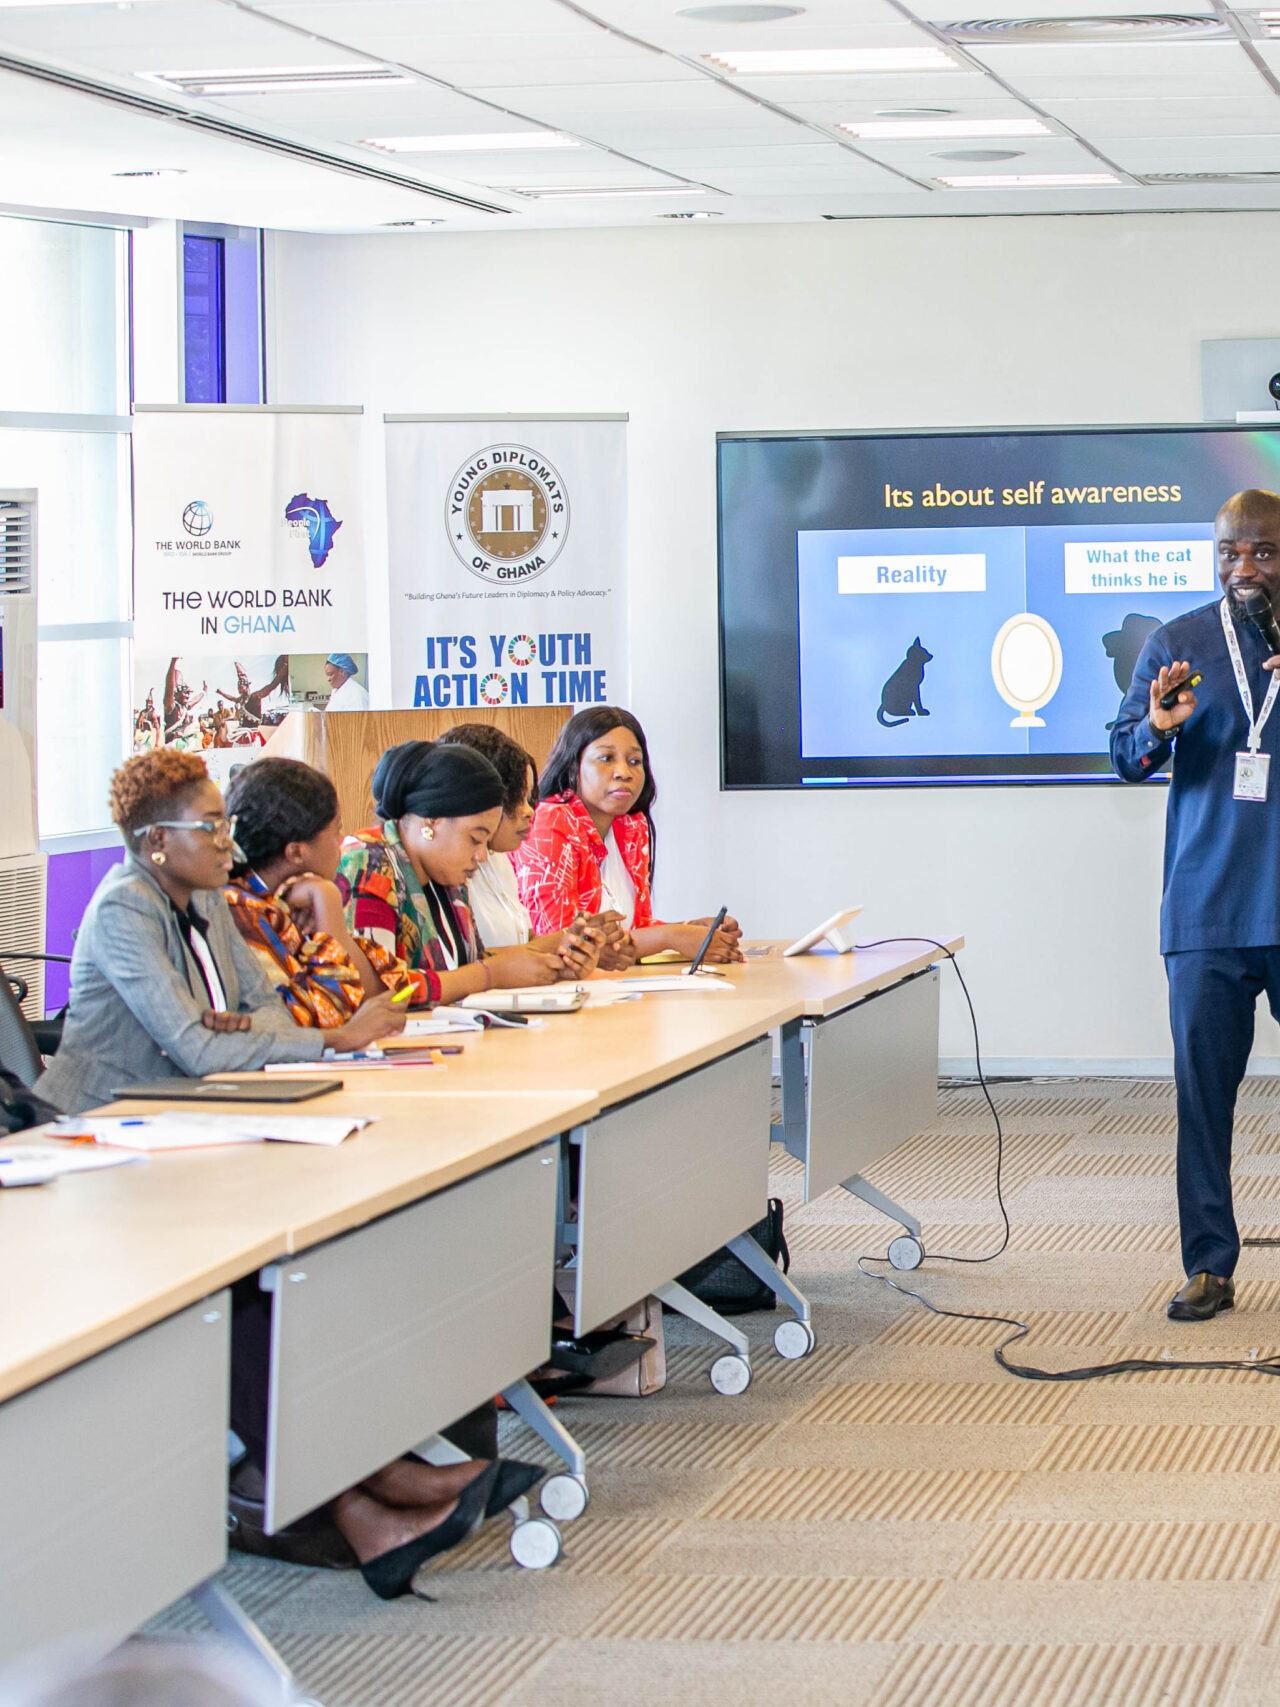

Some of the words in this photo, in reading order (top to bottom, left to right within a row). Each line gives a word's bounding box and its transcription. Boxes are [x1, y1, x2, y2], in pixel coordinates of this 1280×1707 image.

[451, 459, 488, 514] YOUNG
[492, 452, 564, 513] DIPLOMATS
[884, 484, 914, 508] Its
[921, 483, 994, 507] about
[1002, 481, 1045, 506] self
[1051, 484, 1182, 504] awareness
[156, 542, 172, 550] THE
[176, 541, 211, 550] WORLD
[214, 540, 241, 549] BANK
[1087, 550, 1127, 564] What
[1134, 549, 1160, 563] the
[1166, 548, 1192, 562] cat
[472, 556, 491, 572] OF
[497, 556, 546, 579] GHANA
[877, 564, 947, 586] Reality
[1091, 573, 1142, 587] thinks
[1149, 573, 1168, 586] he
[1174, 573, 1187, 586] is
[208, 590, 276, 608] WORLD
[283, 589, 332, 607] BANK
[517, 590, 549, 598] Diplomacy
[557, 590, 575, 598] Policy
[201, 617, 218, 634] IN
[224, 615, 295, 634] GHANA
[427, 636, 477, 669] IT'S
[490, 633, 591, 667] YOUTH
[414, 672, 528, 708] ACTION
[541, 670, 606, 704] TIME
